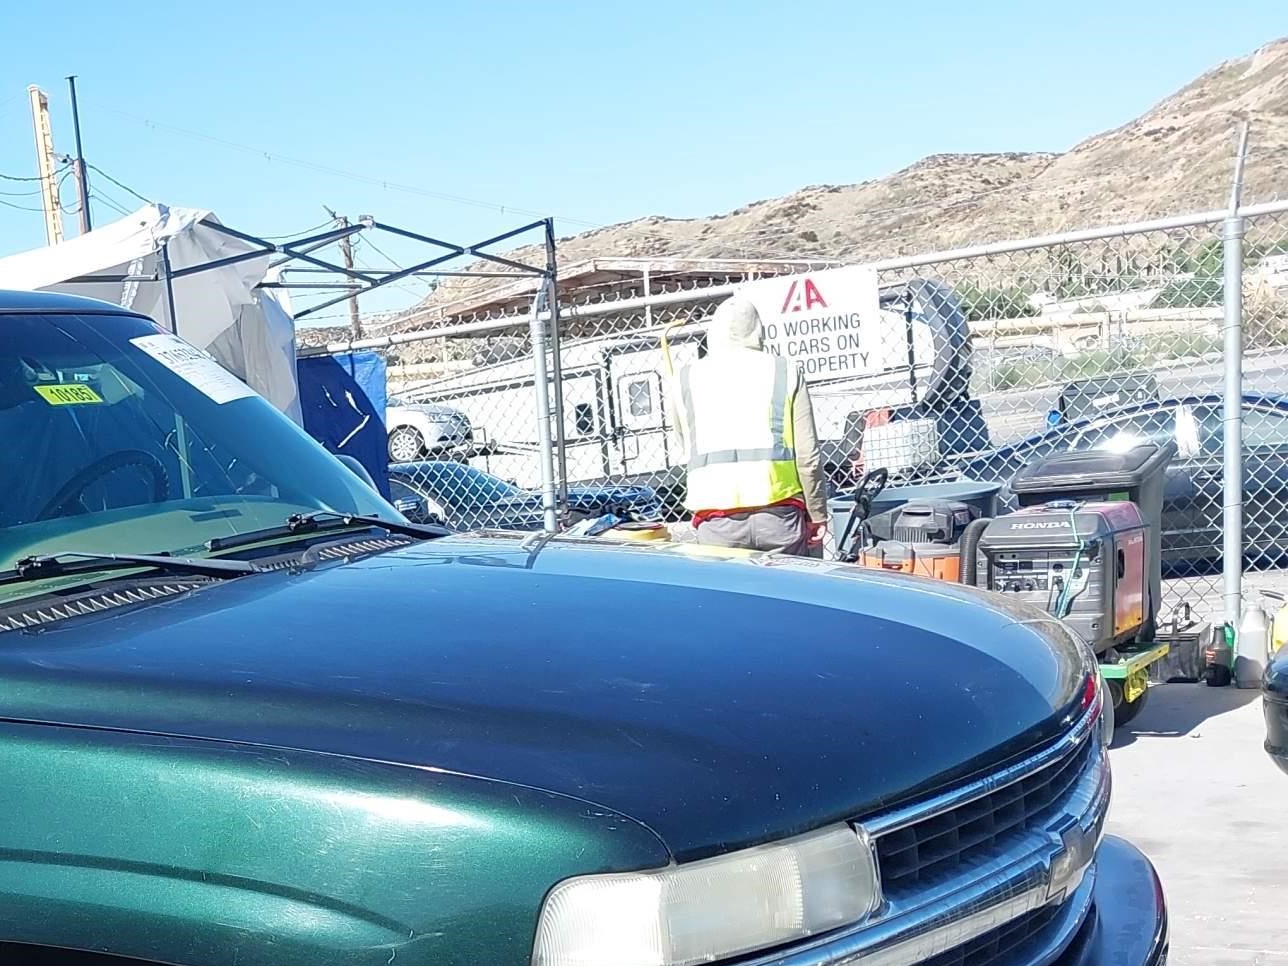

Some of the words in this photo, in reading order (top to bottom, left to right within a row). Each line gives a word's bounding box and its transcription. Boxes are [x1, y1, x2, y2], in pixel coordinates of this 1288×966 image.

[783, 313, 861, 337] WORKING
[787, 337, 831, 357] CARS
[837, 333, 860, 350] ON
[795, 352, 870, 374] ROPERTY
[1010, 521, 1072, 530] HONDA
